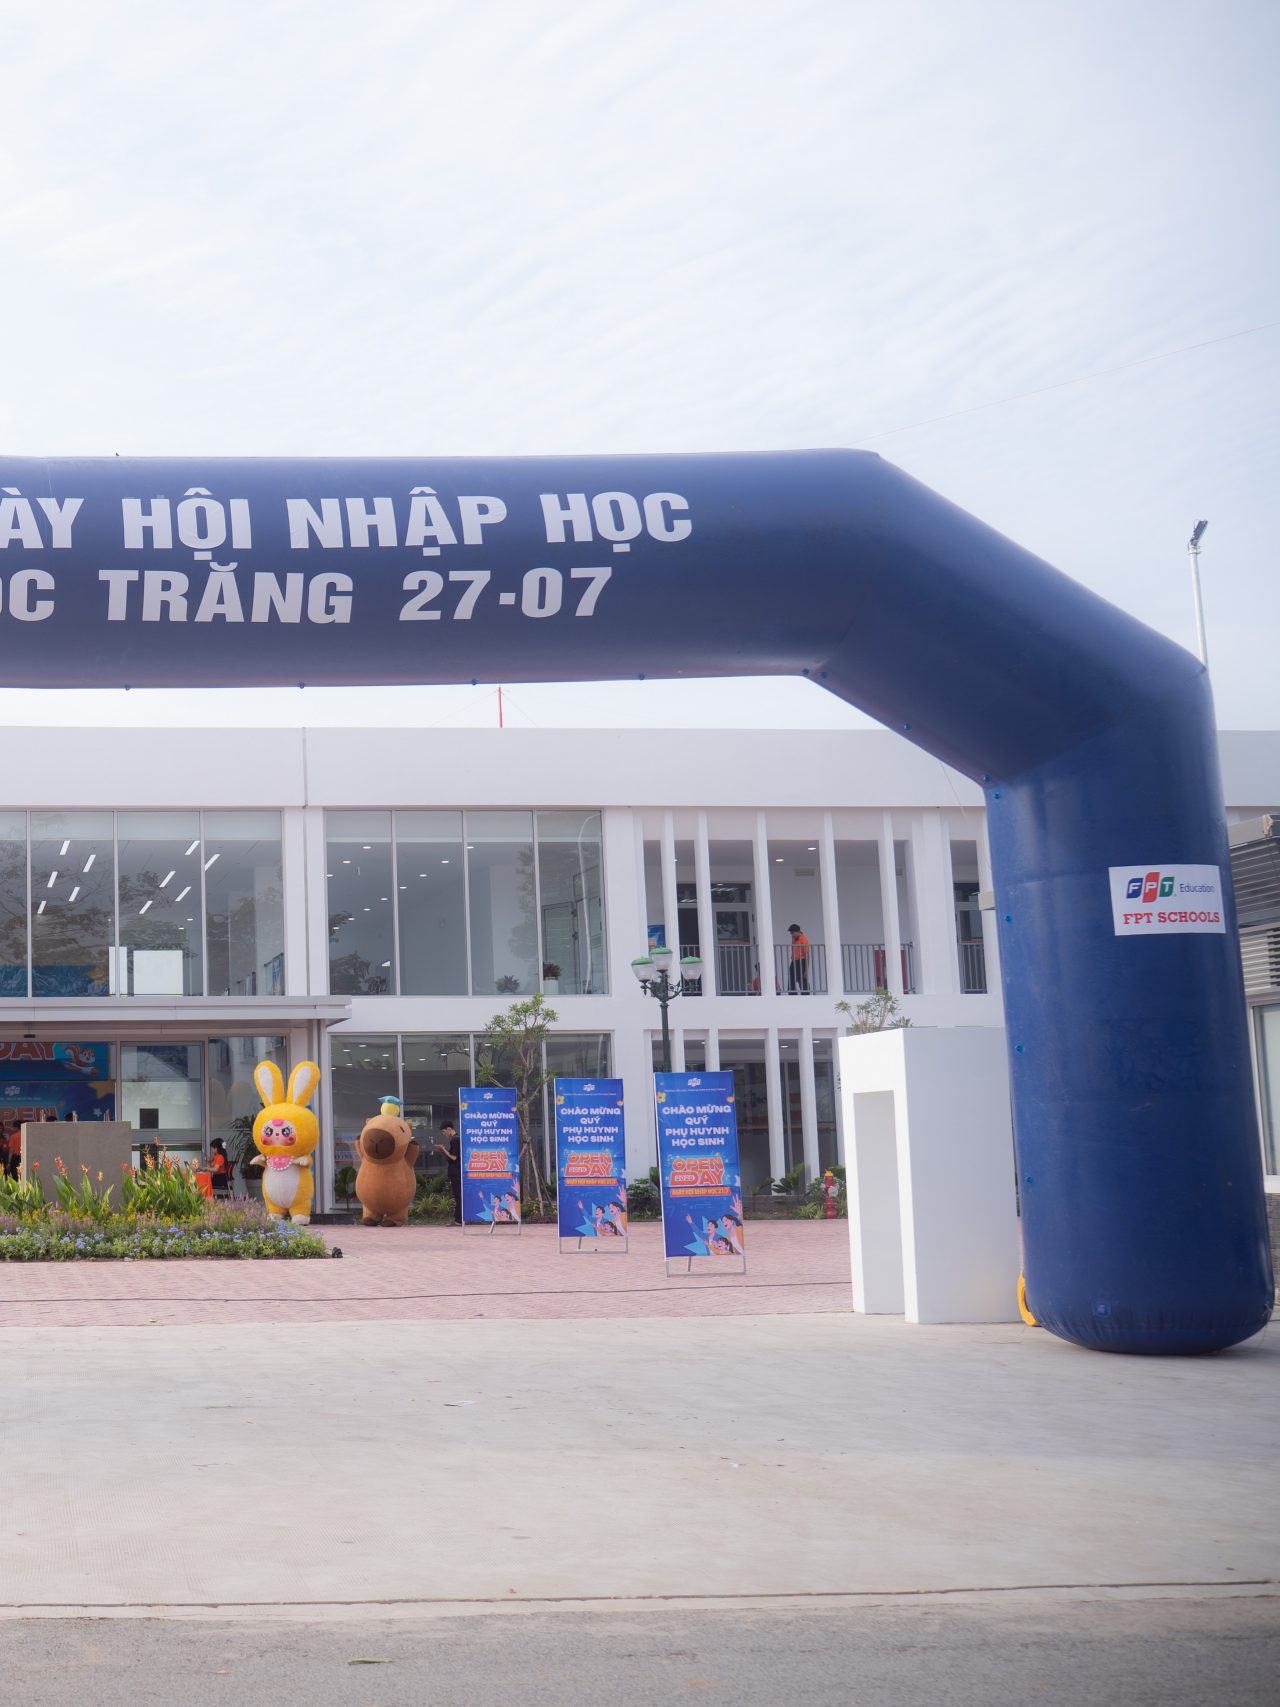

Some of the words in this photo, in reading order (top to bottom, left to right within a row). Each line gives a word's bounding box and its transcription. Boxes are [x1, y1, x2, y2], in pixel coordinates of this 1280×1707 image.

[121, 487, 252, 560] HỘI
[286, 486, 507, 556] NHẬP
[539, 491, 692, 553] HỌC
[98, 562, 354, 624] TRĂNG
[399, 566, 612, 621] 27-07
[1179, 883, 1216, 893] Education
[1122, 912, 1153, 925] FPT
[1157, 911, 1220, 923] SCHOOLS
[464, 1111, 488, 1119] CHÀO
[489, 1111, 514, 1119] MỪNG
[560, 1106, 588, 1115] CHÀO
[589, 1106, 621, 1115] MỪNG
[662, 1105, 694, 1115] CHÀO
[696, 1104, 732, 1114] MỪNG
[580, 1117, 601, 1125] QUÝ
[685, 1115, 709, 1126] QUÝ
[466, 1128, 483, 1136] PHỤ
[563, 1126, 583, 1135] PHỤ
[584, 1126, 618, 1134] HUYNH
[665, 1128, 688, 1138] PHỤ
[689, 1127, 729, 1136] HUYNH
[568, 1136, 588, 1144] HỌC
[671, 1138, 696, 1148] HỌC
[697, 1137, 725, 1146] SINH
[471, 1151, 507, 1160] OPEN
[568, 1153, 611, 1164] OPEN
[468, 1160, 508, 1171] DAY
[565, 1163, 612, 1177] DAY
[672, 1158, 724, 1172] OPEN
[670, 1170, 724, 1186] DAY
